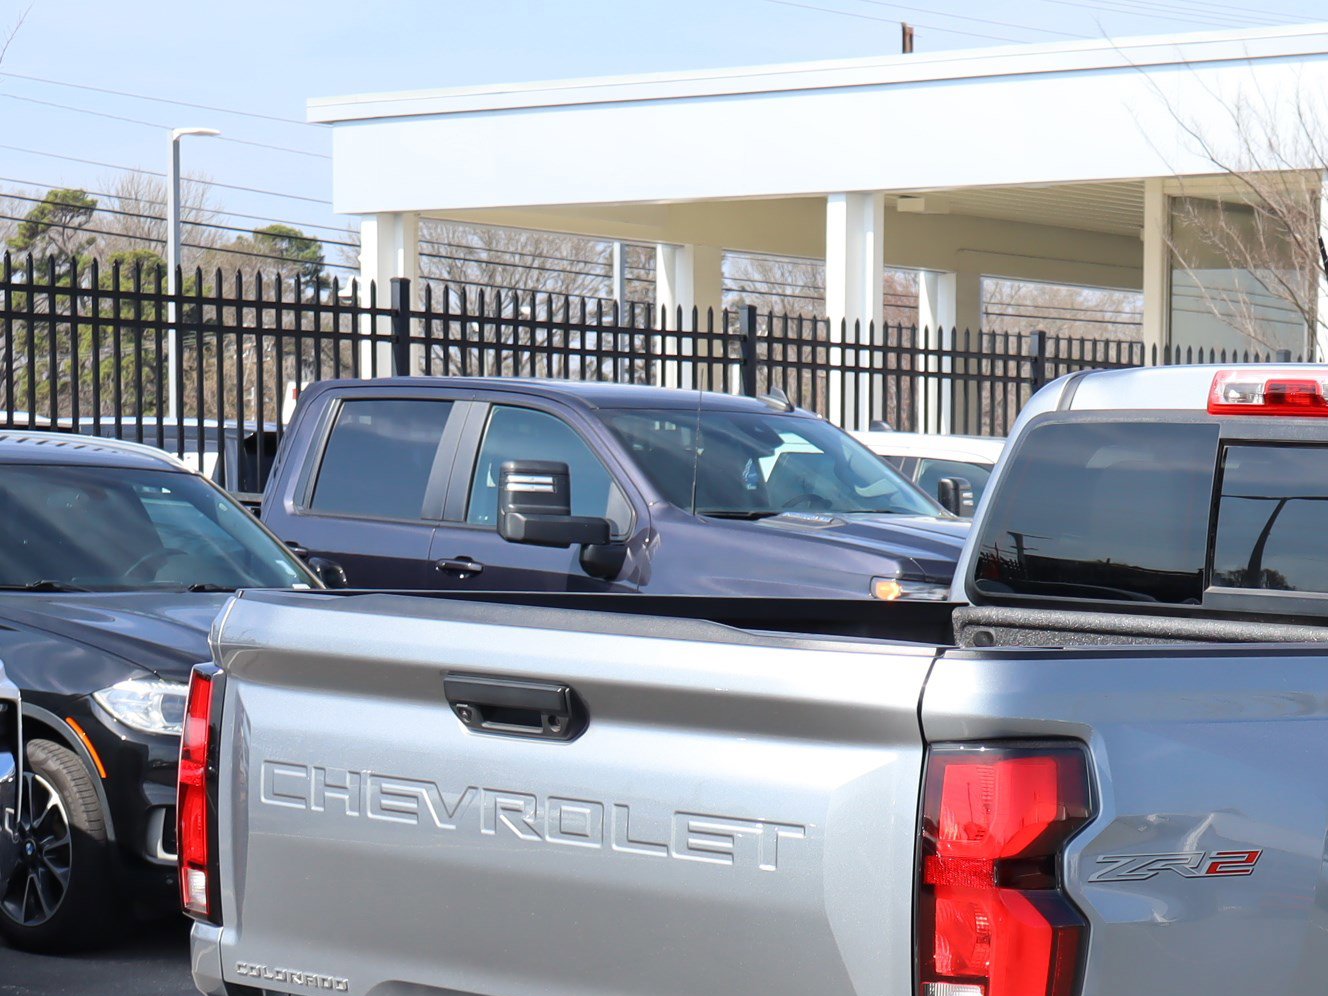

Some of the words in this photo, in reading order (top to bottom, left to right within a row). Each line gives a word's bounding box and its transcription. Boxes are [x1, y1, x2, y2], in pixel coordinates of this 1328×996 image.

[259, 758, 806, 872] CHEVROLET
[1088, 849, 1263, 883] ZR2
[235, 960, 349, 992] COLORADO
